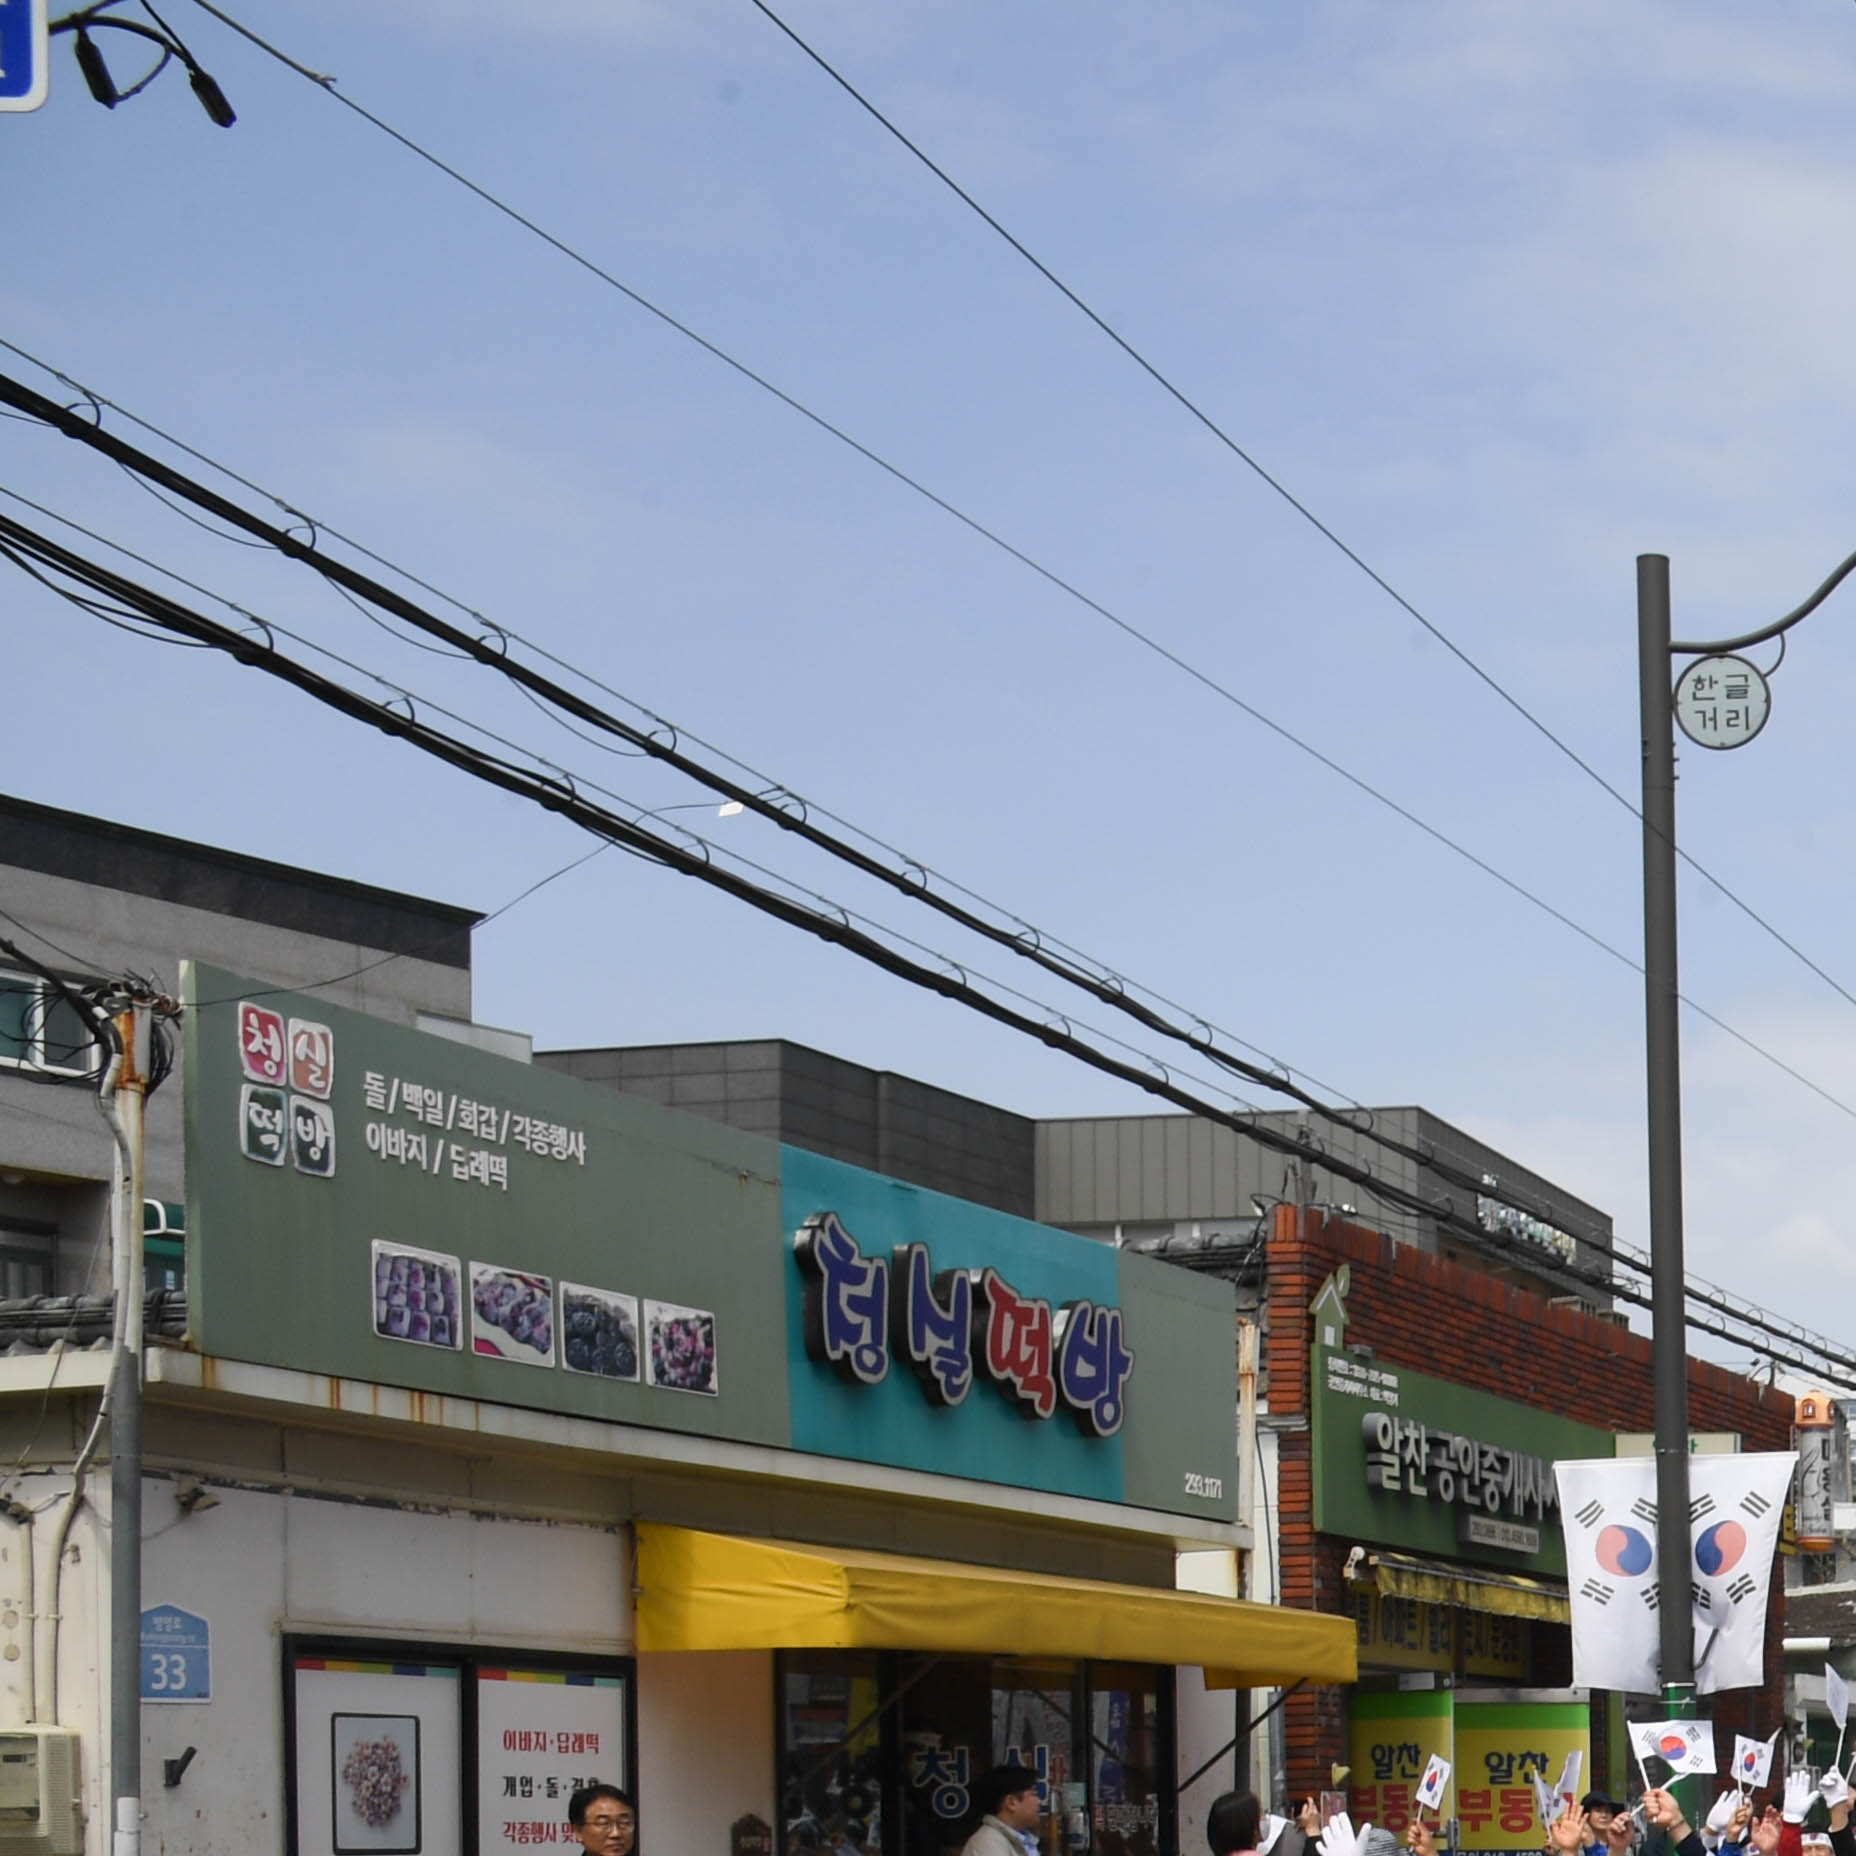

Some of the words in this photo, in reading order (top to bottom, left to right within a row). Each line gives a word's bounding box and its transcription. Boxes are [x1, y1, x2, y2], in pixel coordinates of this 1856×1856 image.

[1692, 674, 1751, 702] 한글
[1694, 706, 1750, 732] 거리
[248, 1012, 327, 1090] 청실
[248, 1099, 331, 1162] 떡방
[808, 1211, 1135, 1438] 청실떡방
[151, 1653, 187, 1691] 33
[1371, 1742, 1421, 1780] 알찬
